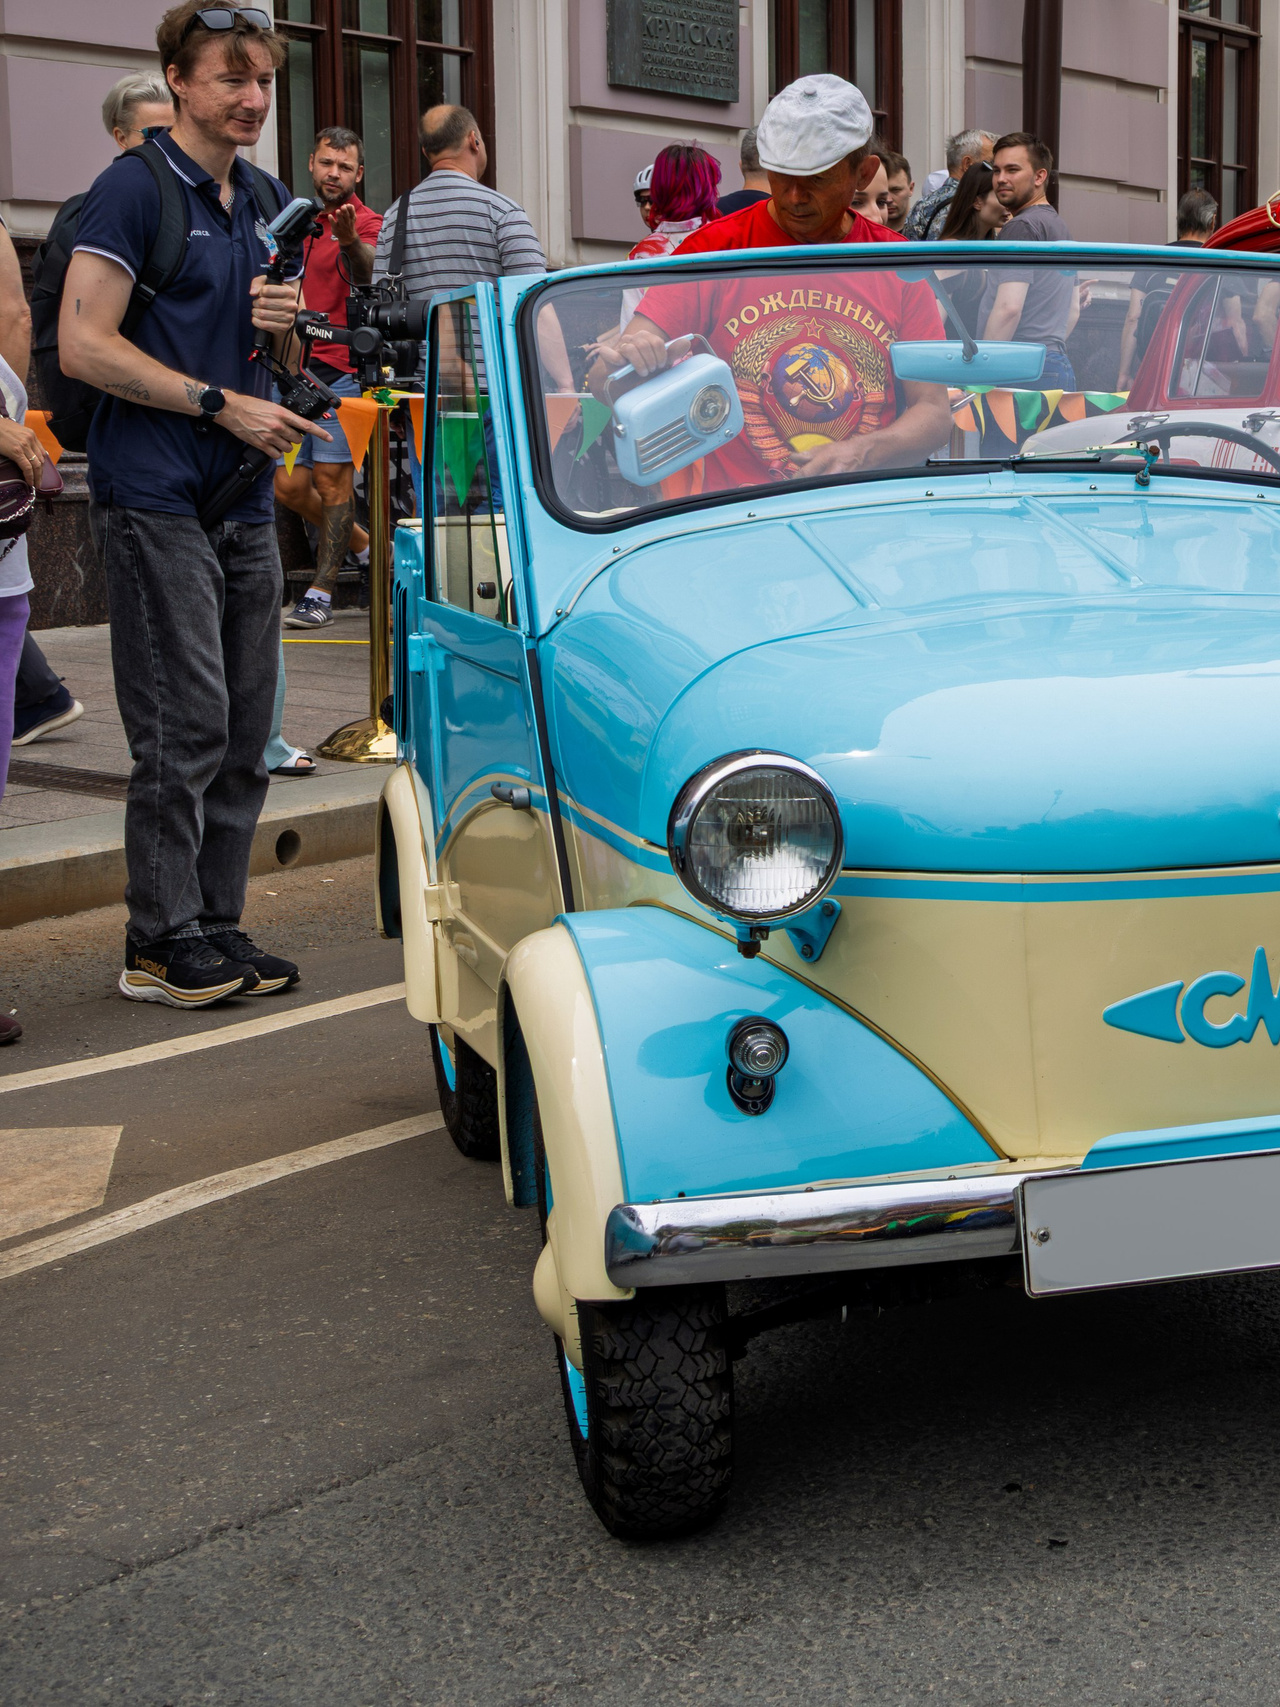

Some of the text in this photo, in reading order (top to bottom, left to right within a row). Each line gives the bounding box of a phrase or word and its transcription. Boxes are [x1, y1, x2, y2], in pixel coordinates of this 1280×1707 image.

[641, 14, 735, 52] КРУПСКАЯ
[306, 324, 333, 340] RONIN
[724, 289, 898, 350] РОЖДЕННЫЙ
[135, 954, 167, 980] HOKA
